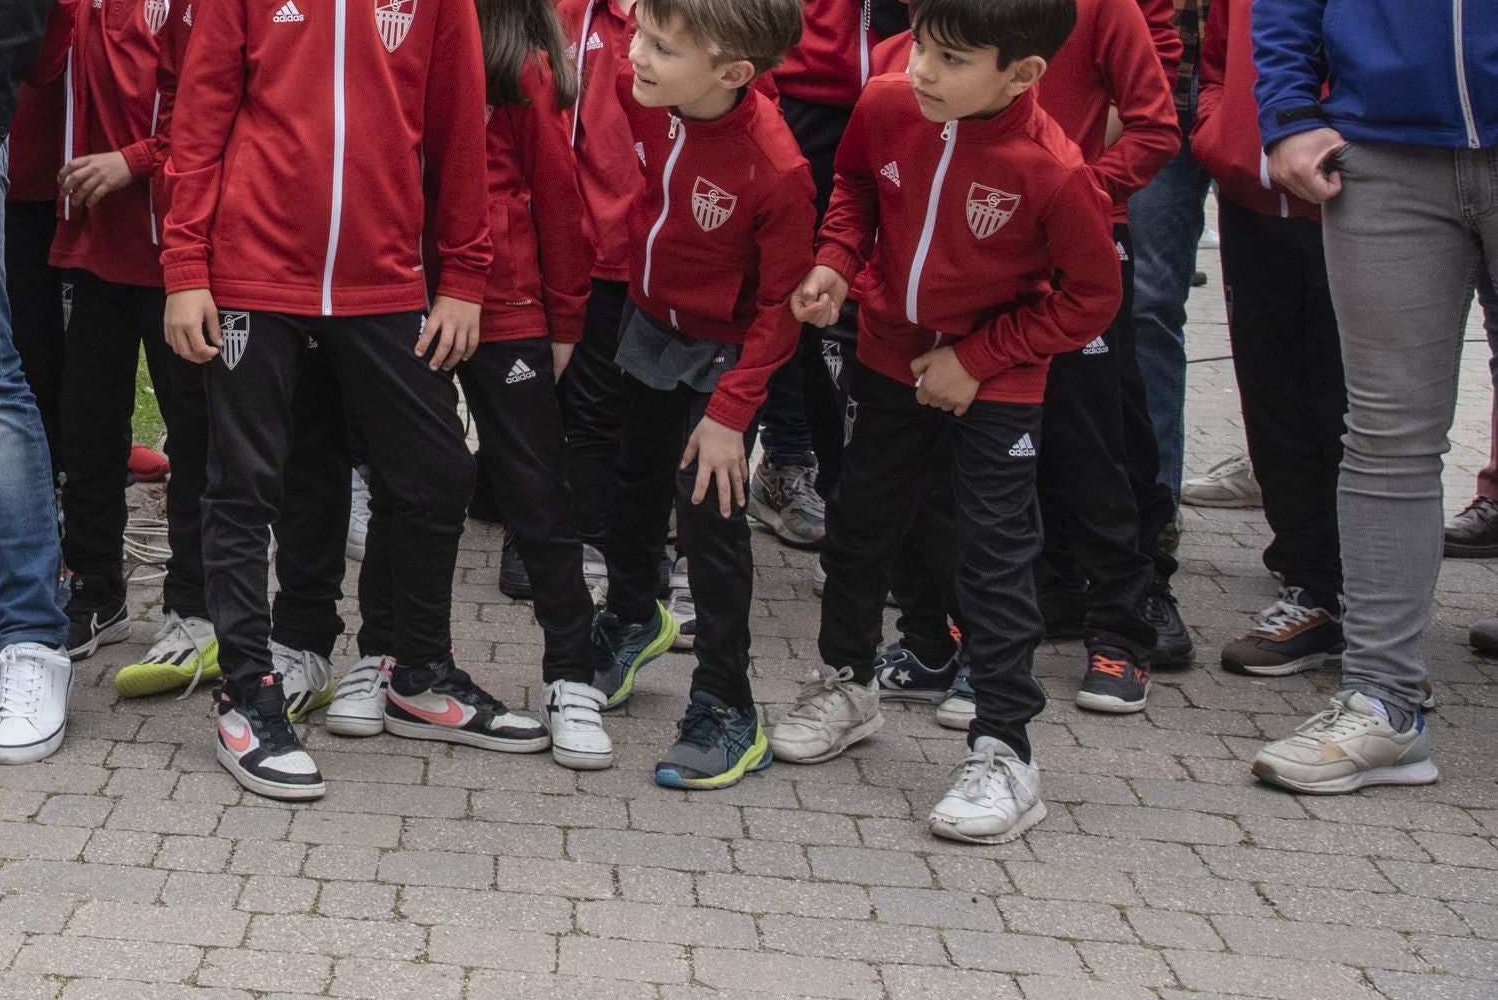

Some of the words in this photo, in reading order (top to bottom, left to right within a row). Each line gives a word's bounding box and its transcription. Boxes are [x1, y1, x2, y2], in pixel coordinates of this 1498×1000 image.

[272, 13, 304, 23] adidas
[1082, 345, 1109, 355] adidas
[505, 370, 537, 384] adidas
